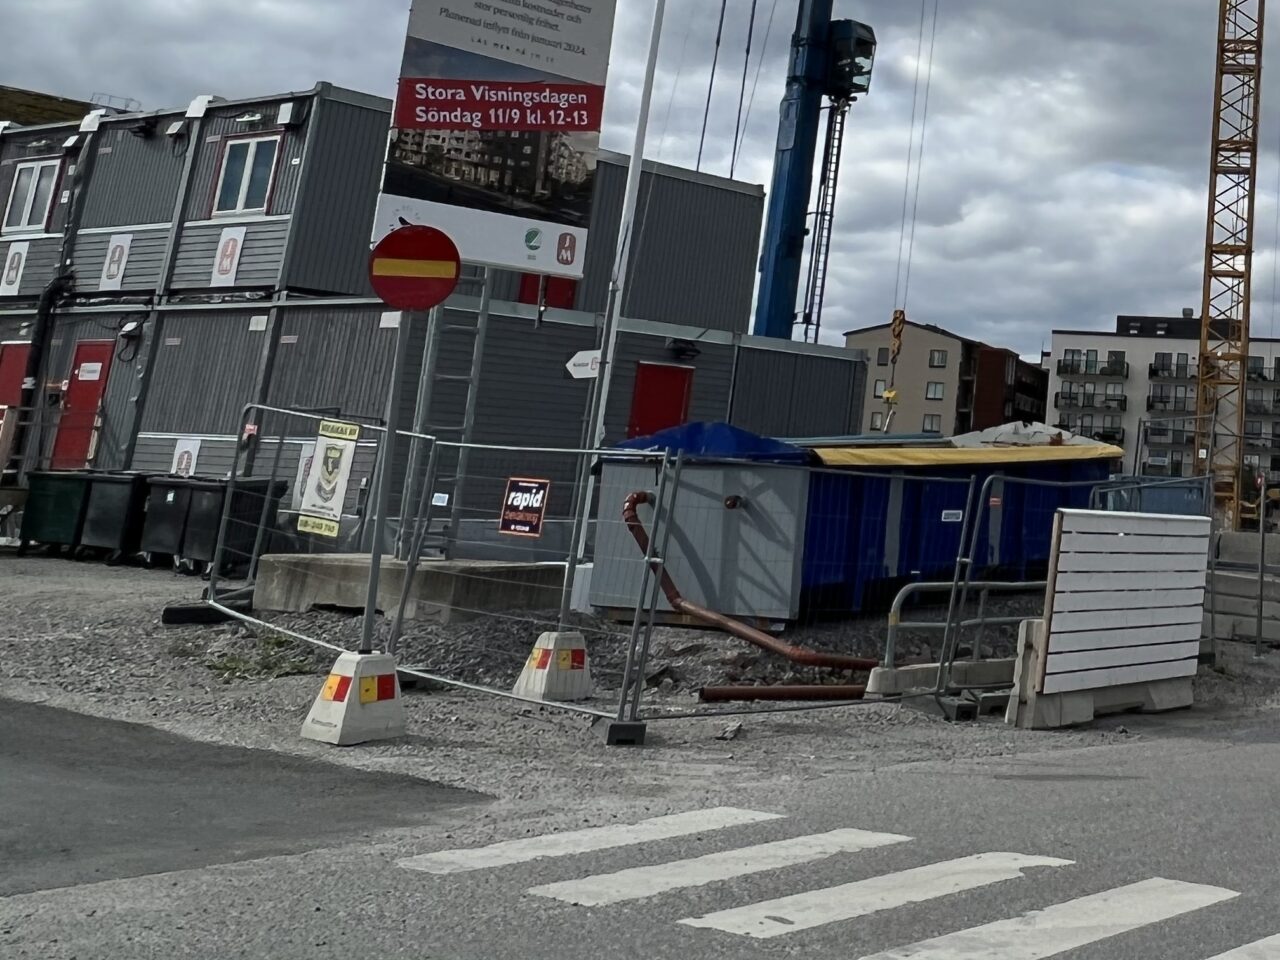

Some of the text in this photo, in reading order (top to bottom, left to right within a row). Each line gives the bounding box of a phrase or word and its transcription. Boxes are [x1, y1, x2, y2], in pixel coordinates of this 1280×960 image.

[415, 84, 587, 108] Stora Visningsdagen
[415, 106, 588, 127] Söndag 11/9 kl. 12-13
